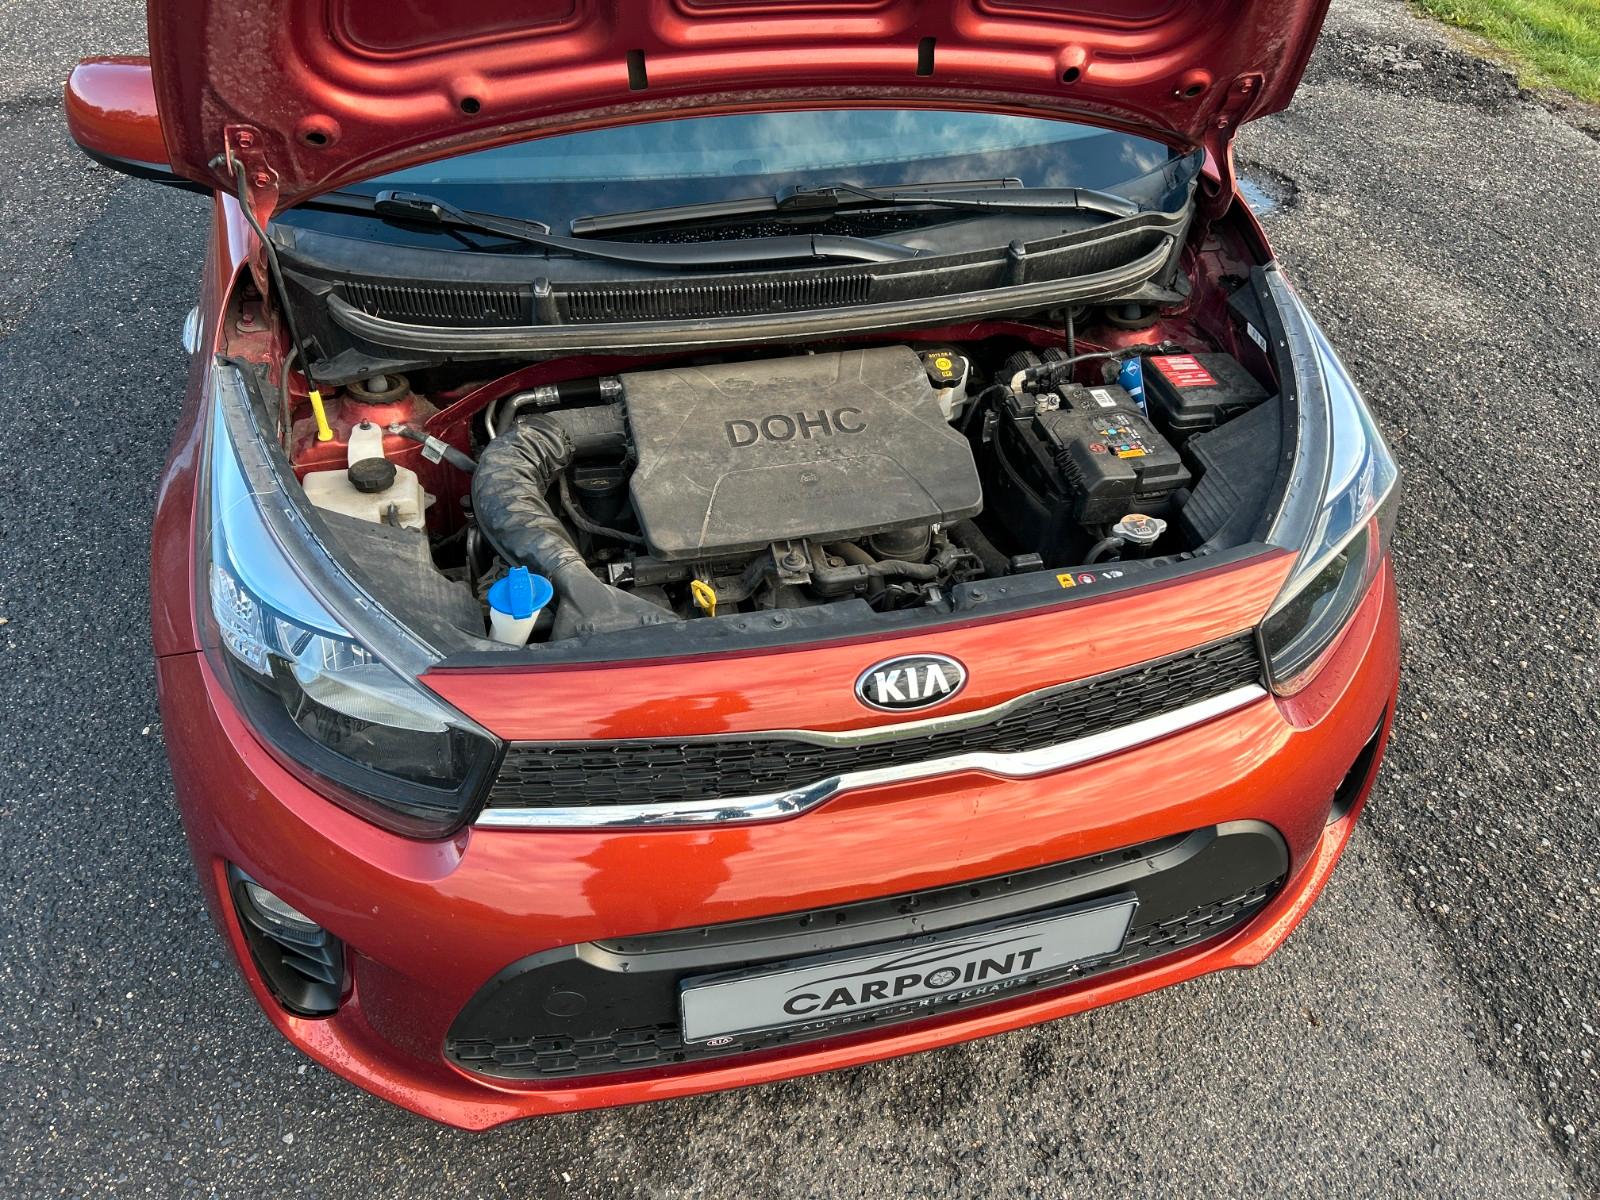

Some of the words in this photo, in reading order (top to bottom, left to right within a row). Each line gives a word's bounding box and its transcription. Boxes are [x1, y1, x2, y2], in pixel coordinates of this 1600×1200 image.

[724, 407, 868, 448] DOHC
[873, 663, 951, 704] KIA
[783, 946, 1042, 1016] CARPOINT
